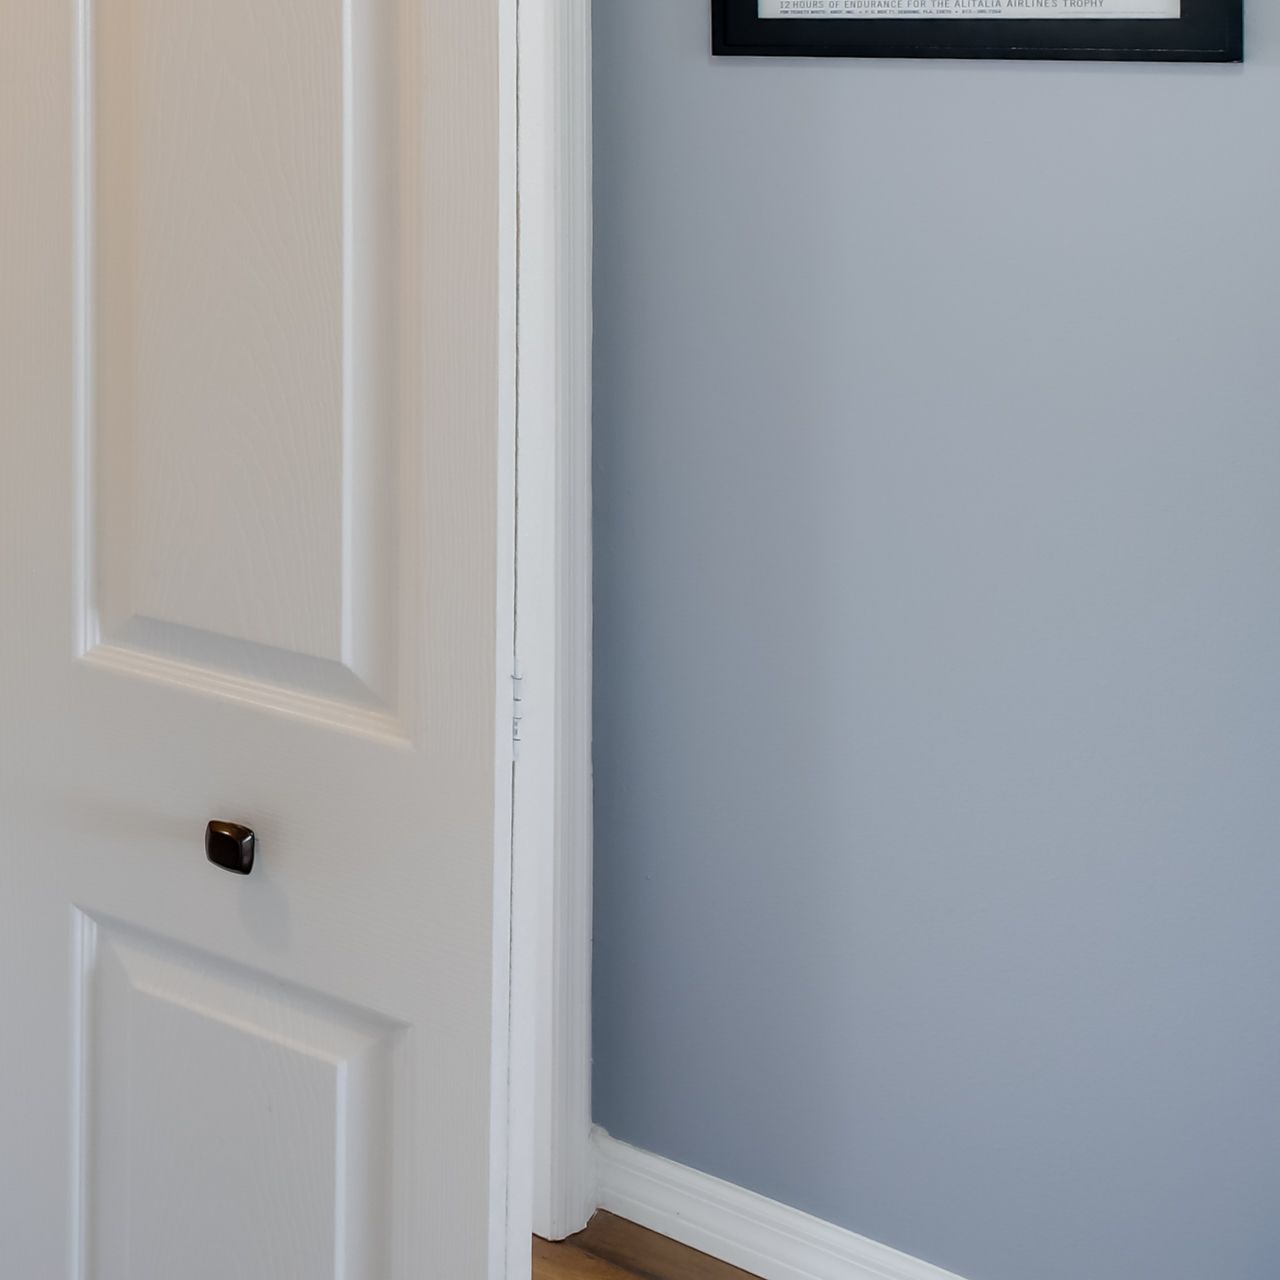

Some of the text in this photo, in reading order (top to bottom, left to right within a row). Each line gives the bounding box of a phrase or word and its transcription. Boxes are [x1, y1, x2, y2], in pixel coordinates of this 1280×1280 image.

[780, 0, 1104, 9] 12 HOURS OF ENDURANCE FOR THE ALITALIA AIRLINES TROPHY
